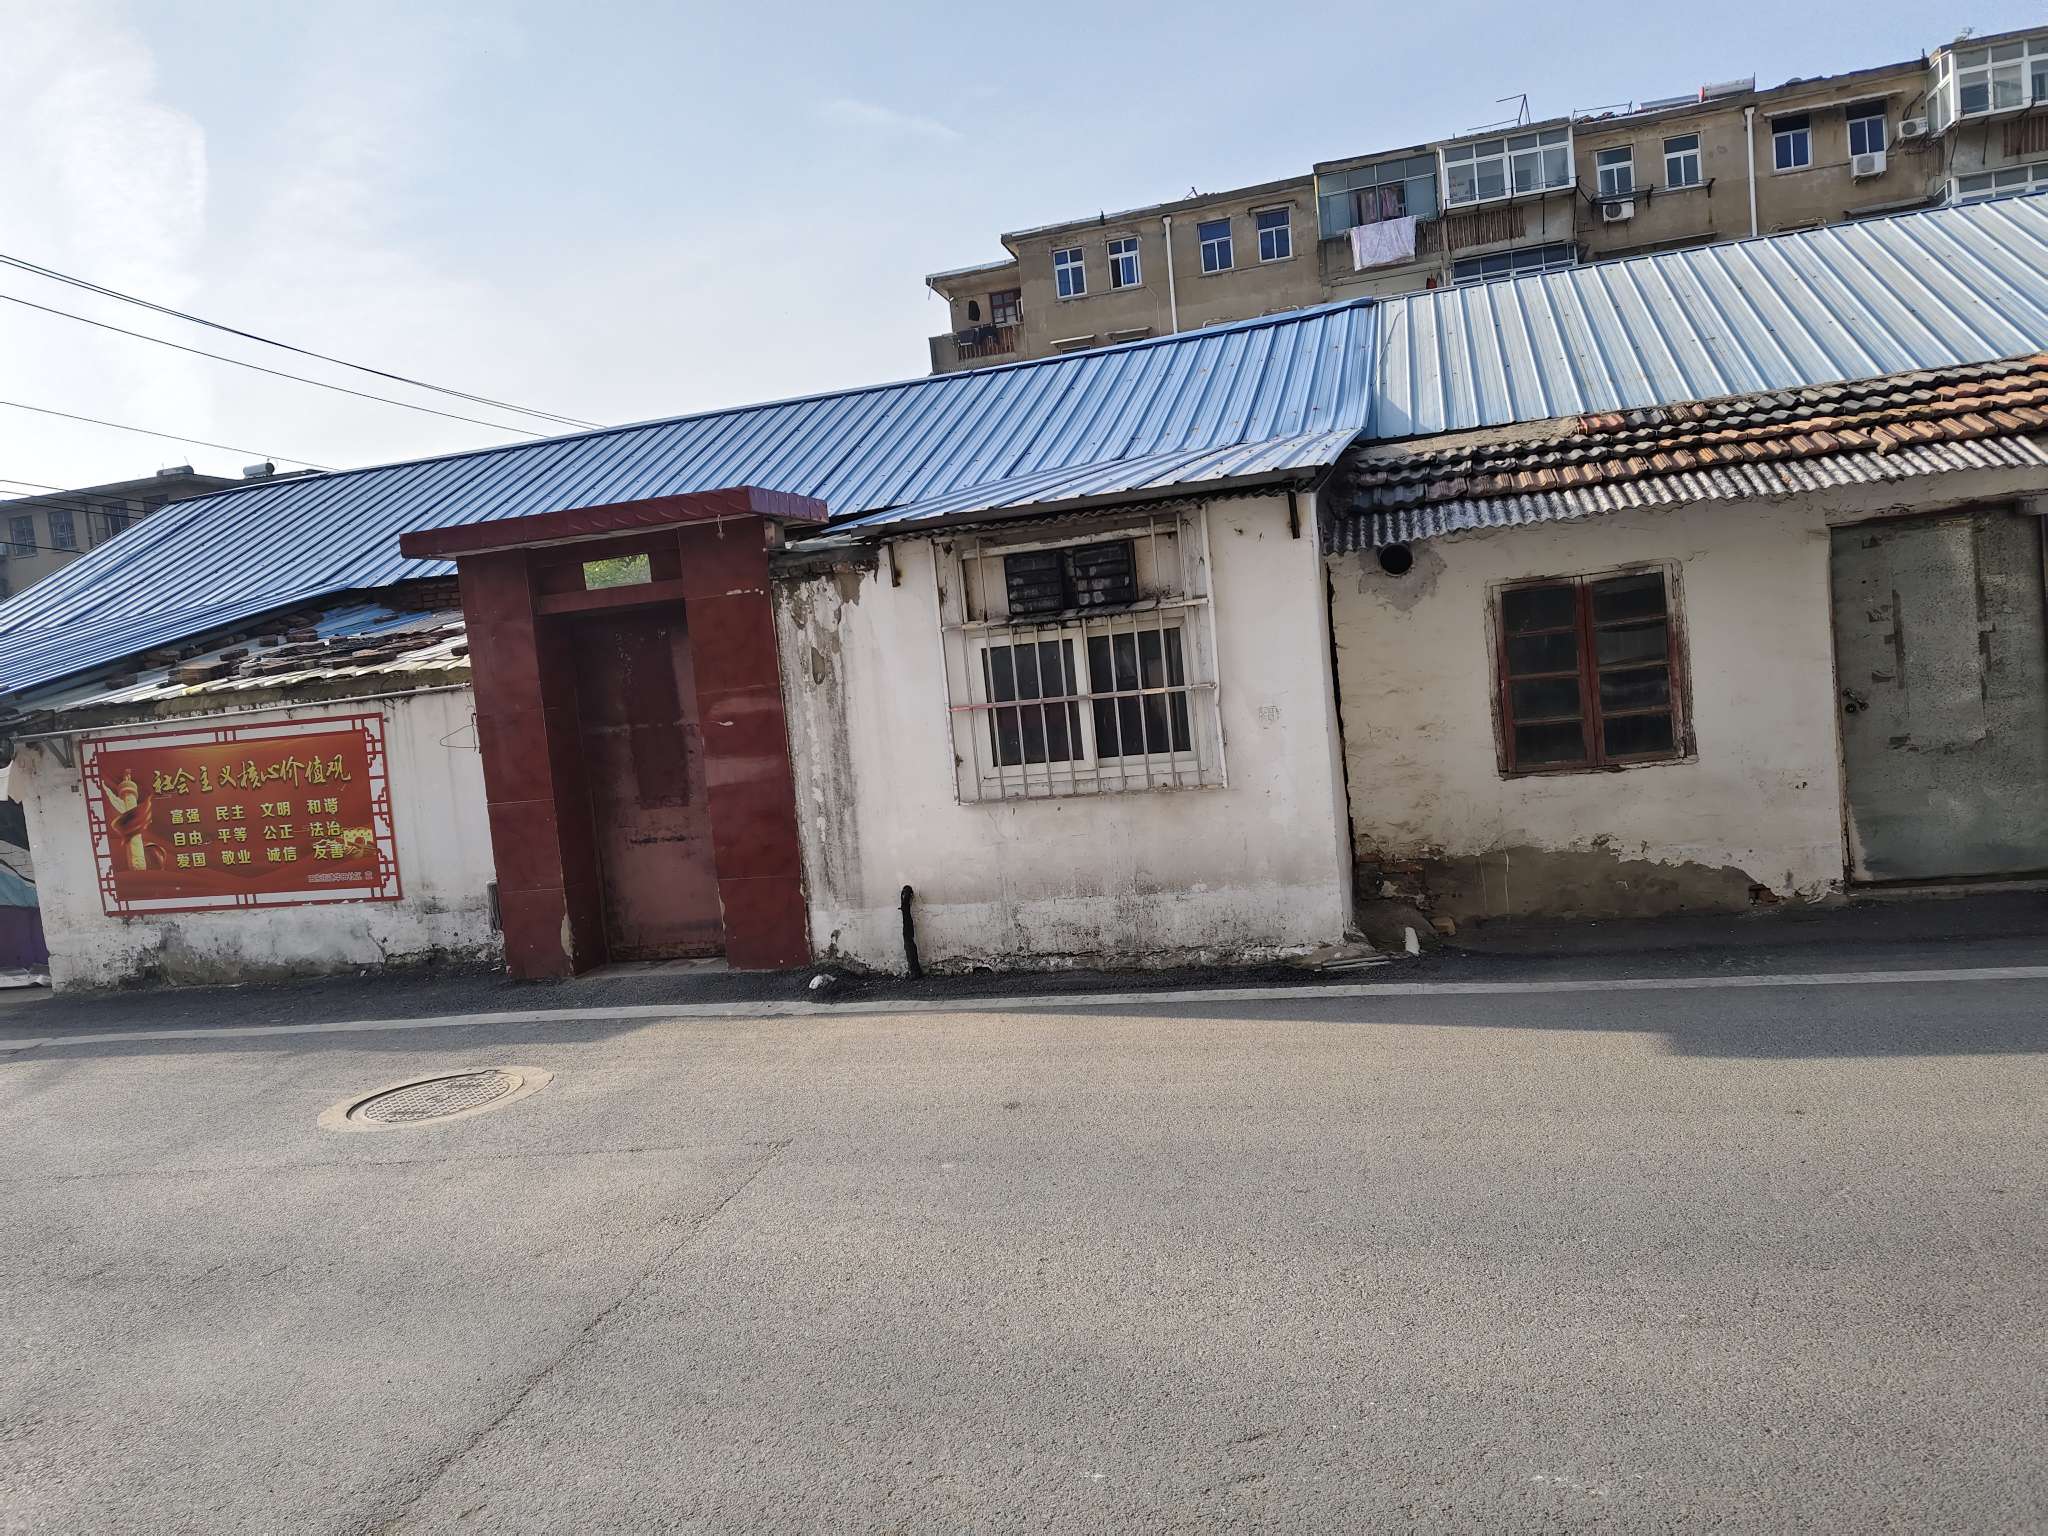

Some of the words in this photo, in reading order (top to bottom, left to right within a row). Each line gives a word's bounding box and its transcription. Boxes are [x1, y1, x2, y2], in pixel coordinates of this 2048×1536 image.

[152, 754, 352, 794] 社会主义核心价值观
[170, 808, 201, 825] 富强
[215, 805, 246, 821] 民主
[260, 801, 291, 817] 文明
[306, 797, 338, 815] 和谐
[173, 830, 203, 847] 自由
[217, 827, 248, 843] 平等
[264, 824, 295, 840] 公正
[310, 821, 342, 838] 法治
[176, 852, 207, 869] 爱国
[221, 849, 252, 866] 敬业
[266, 846, 298, 863] 诚信
[313, 843, 346, 860] 友善
